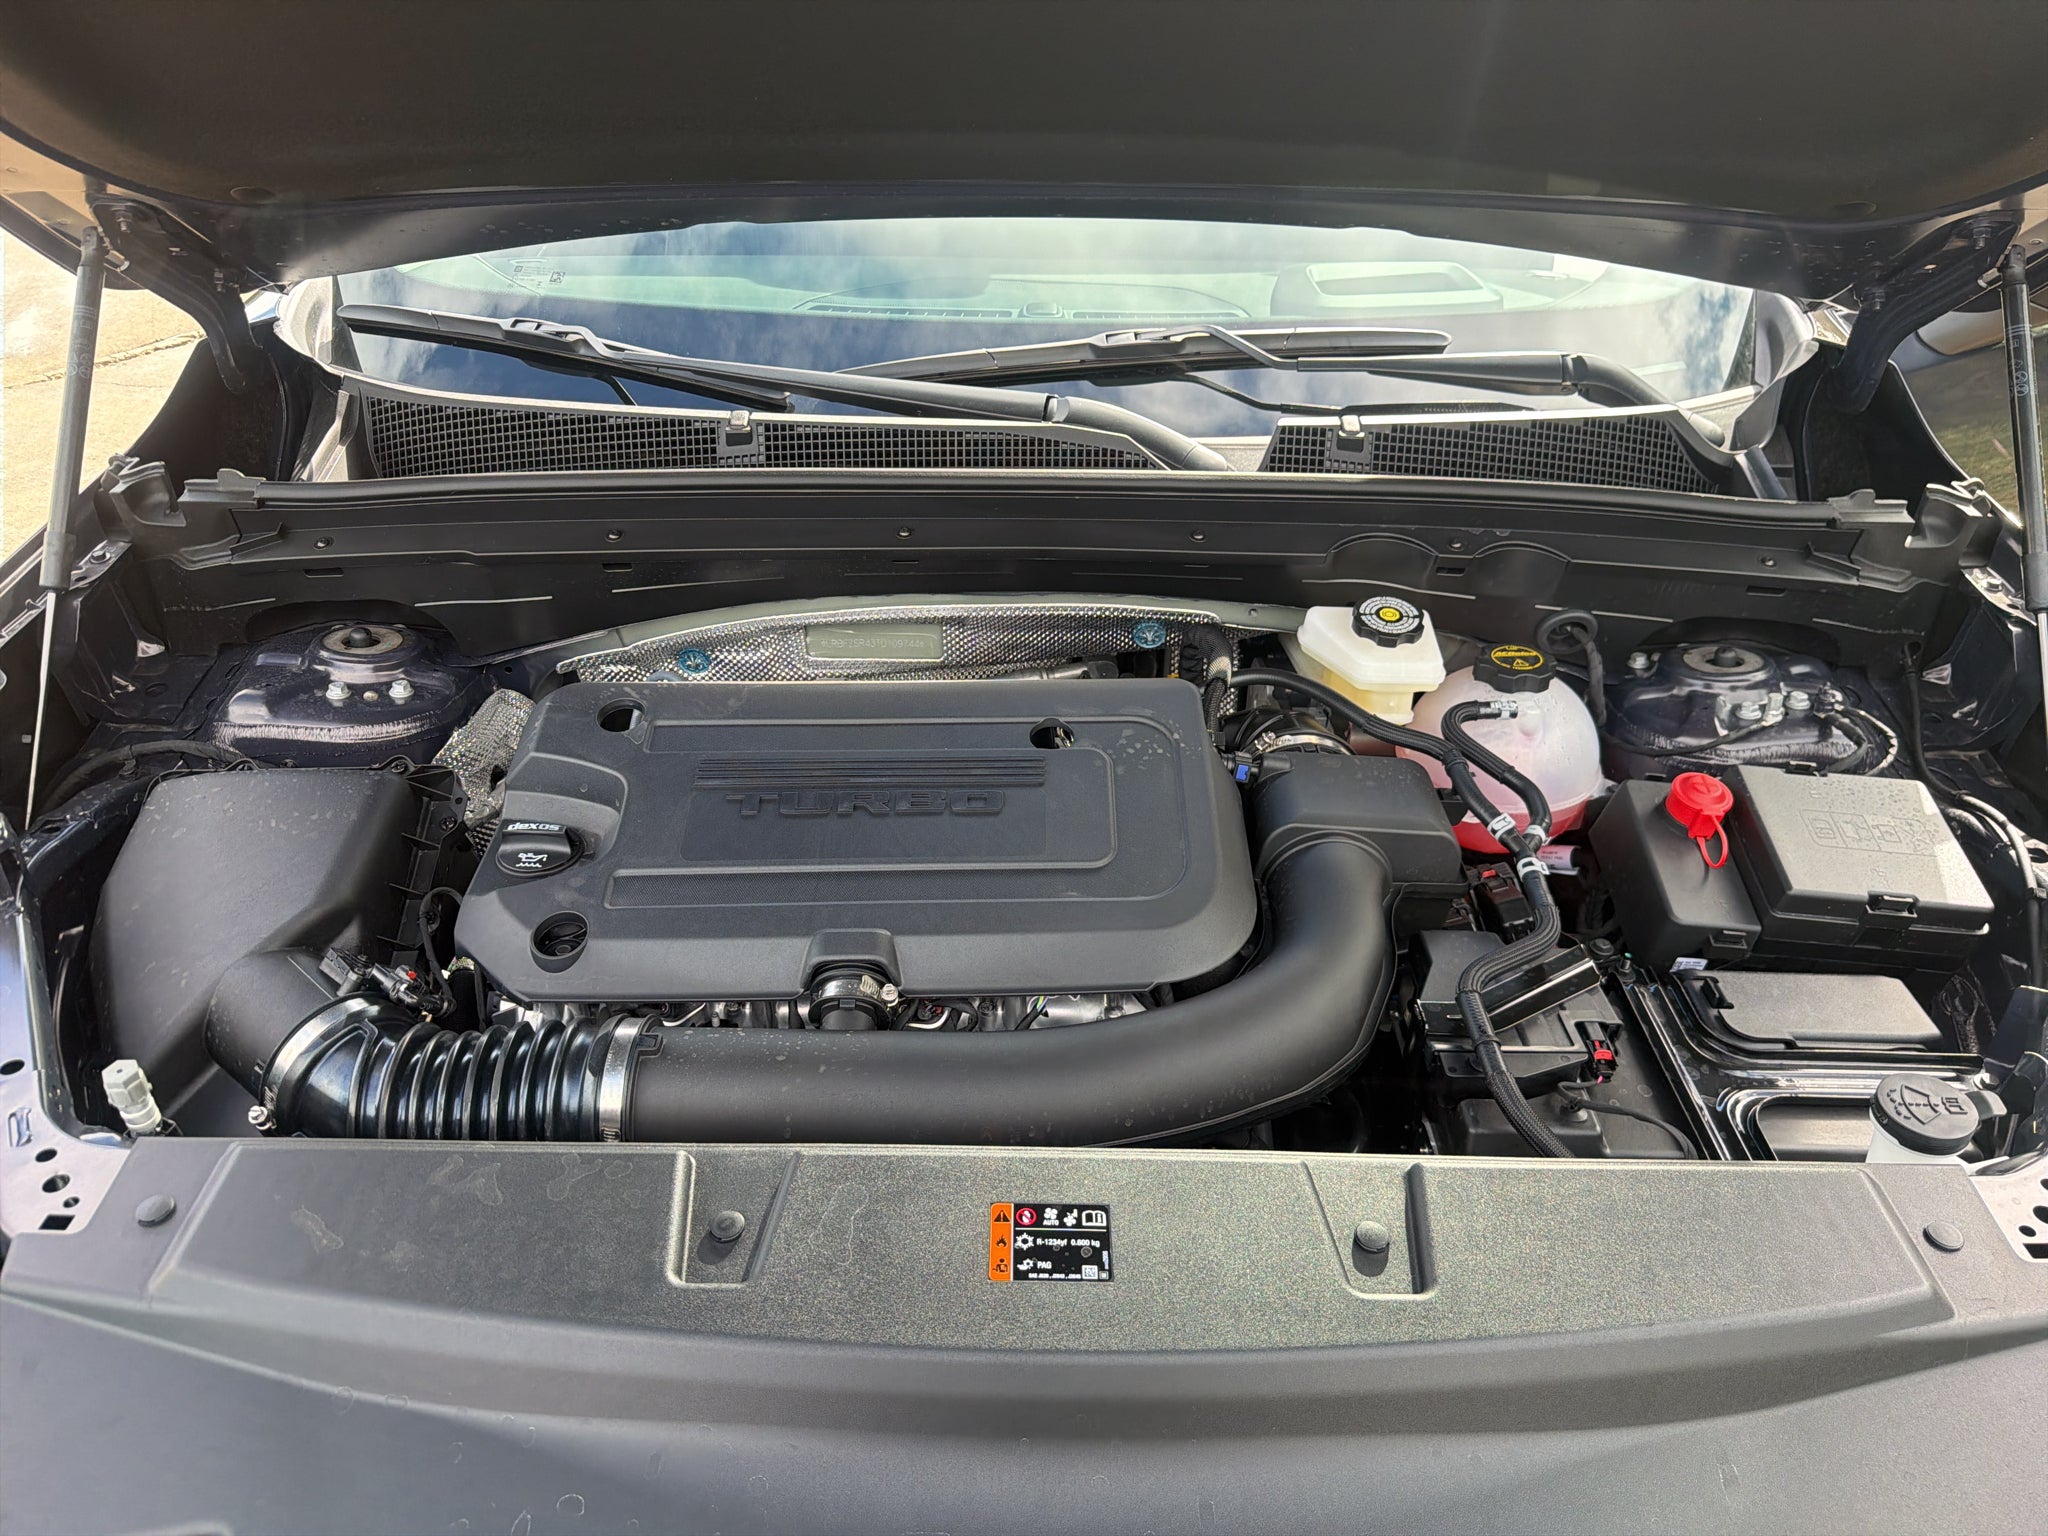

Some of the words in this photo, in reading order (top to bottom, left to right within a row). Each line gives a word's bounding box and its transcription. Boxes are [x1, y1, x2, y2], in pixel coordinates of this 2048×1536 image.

[726, 789, 1005, 816] TURBO
[507, 822, 561, 831] dexos
[1036, 1238, 1067, 1247] R-1234yf
[1091, 1239, 1100, 1248] kg
[1037, 1261, 1052, 1269] PAG
